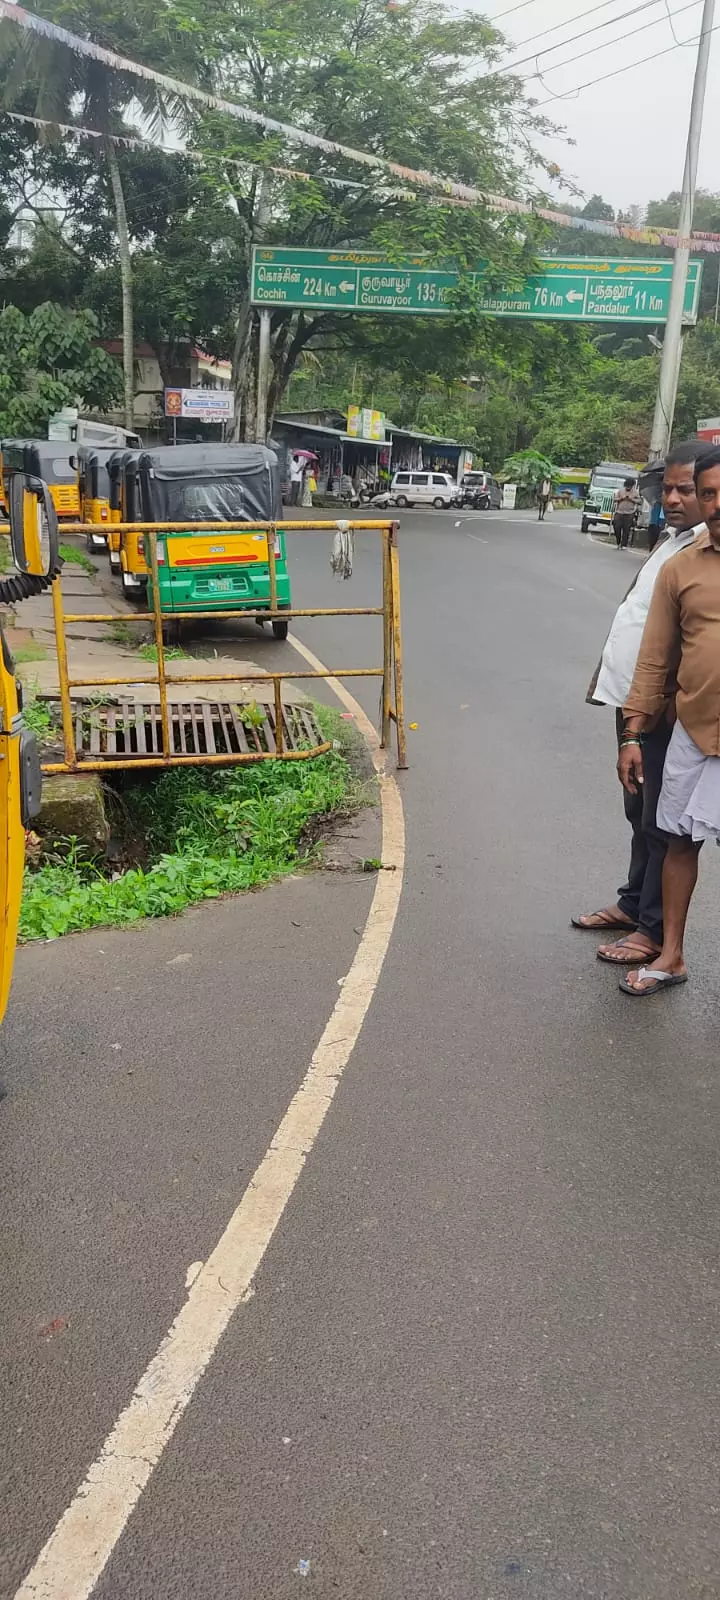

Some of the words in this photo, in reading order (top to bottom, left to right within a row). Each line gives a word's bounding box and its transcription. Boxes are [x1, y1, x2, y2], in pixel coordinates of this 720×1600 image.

[257, 266, 301, 283] கொச்சின்
[361, 273, 411, 293] குருவாயூர்
[257, 287, 287, 299] Cochin
[303, 278, 323, 296] 224
[324, 283, 337, 297] Km
[416, 283, 436, 302] 135
[534, 287, 548, 306] 76
[549, 292, 563, 306] Km
[589, 281, 634, 300] பந்தலூர்
[361, 292, 412, 307] Guruvayoor
[587, 302, 630, 315] Pandalur
[634, 291, 646, 310] 11
[649, 296, 663, 310] Km
